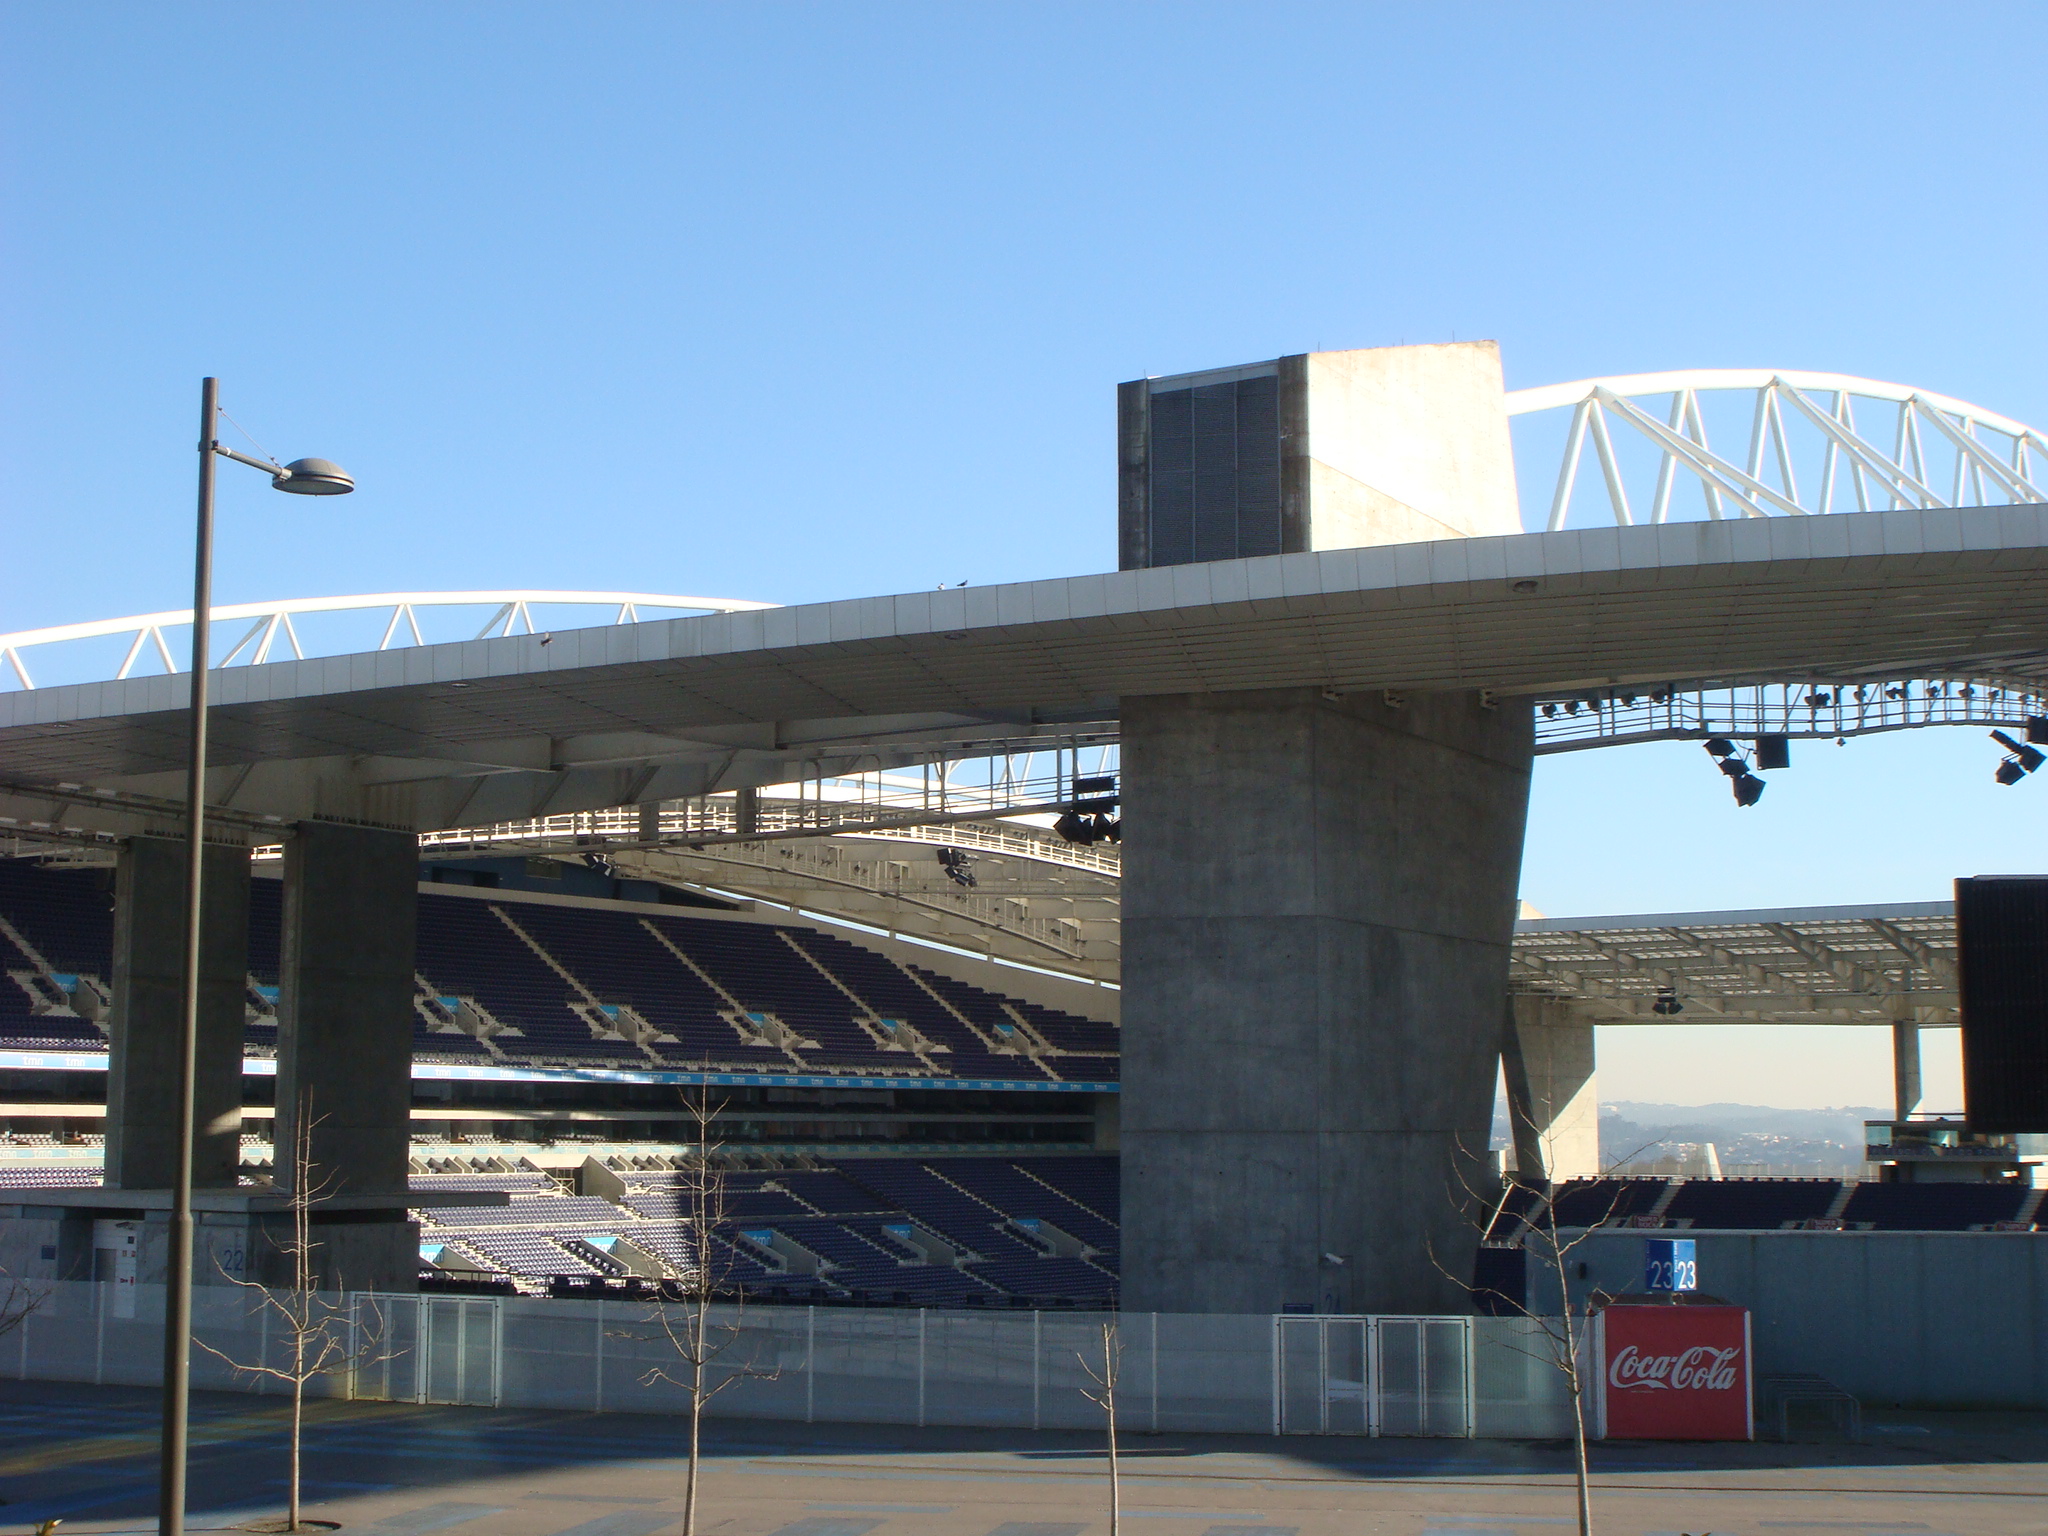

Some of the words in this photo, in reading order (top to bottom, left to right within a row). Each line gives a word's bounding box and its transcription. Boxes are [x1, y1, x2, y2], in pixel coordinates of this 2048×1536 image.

[22, 1056, 44, 1066] tmn
[64, 1057, 86, 1067] tmn
[434, 1068, 452, 1077] tmn
[467, 1069, 483, 1077] tmn
[499, 1069, 515, 1078] tmn
[223, 1249, 243, 1271] 22
[1651, 1260, 1673, 1289] 23
[1677, 1260, 1697, 1289] 23
[1609, 1345, 1741, 1390] Coca-Cola
